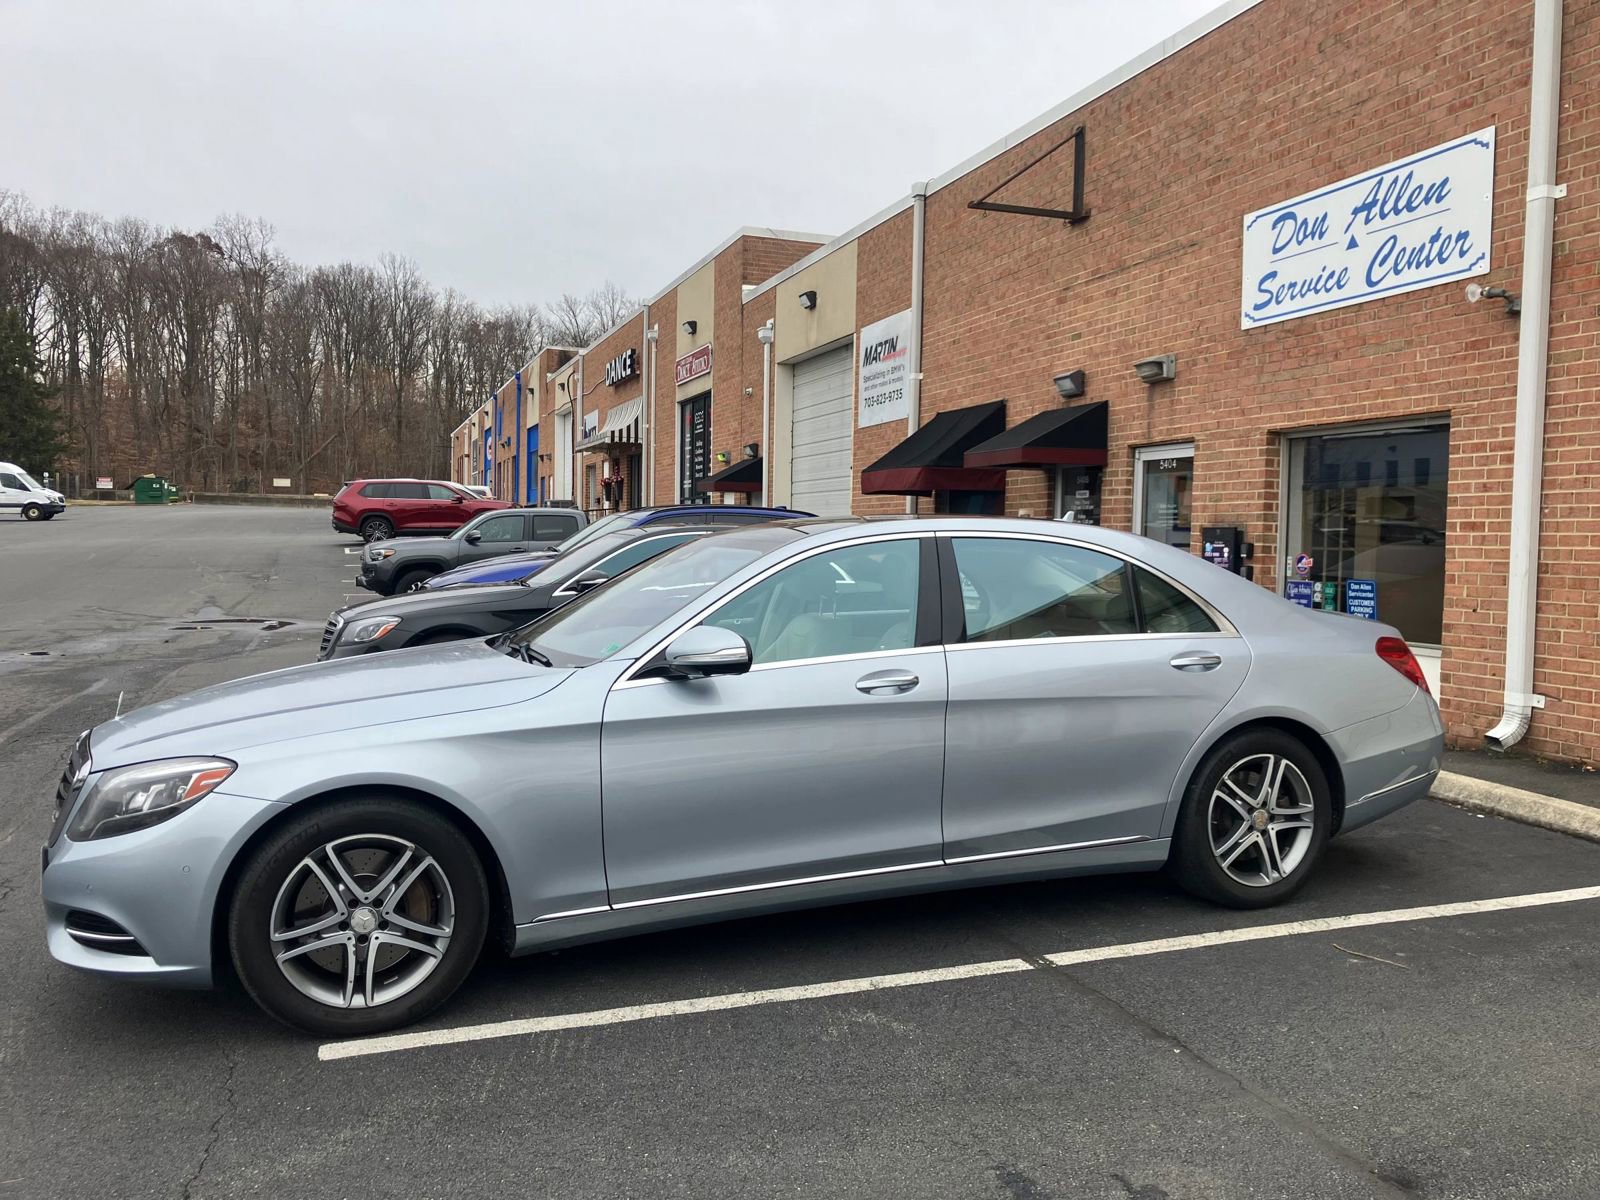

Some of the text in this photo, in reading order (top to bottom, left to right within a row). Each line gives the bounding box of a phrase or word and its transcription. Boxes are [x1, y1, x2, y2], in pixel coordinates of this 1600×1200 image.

[1271, 170, 1452, 255] Don Allen
[1253, 226, 1474, 311] Service Center
[605, 349, 632, 387] DANCE
[862, 335, 899, 368] MARTIN
[1159, 458, 1177, 470] 5404
[1348, 599, 1375, 607] CUSTOMER
[1350, 606, 1373, 614] PARKING
